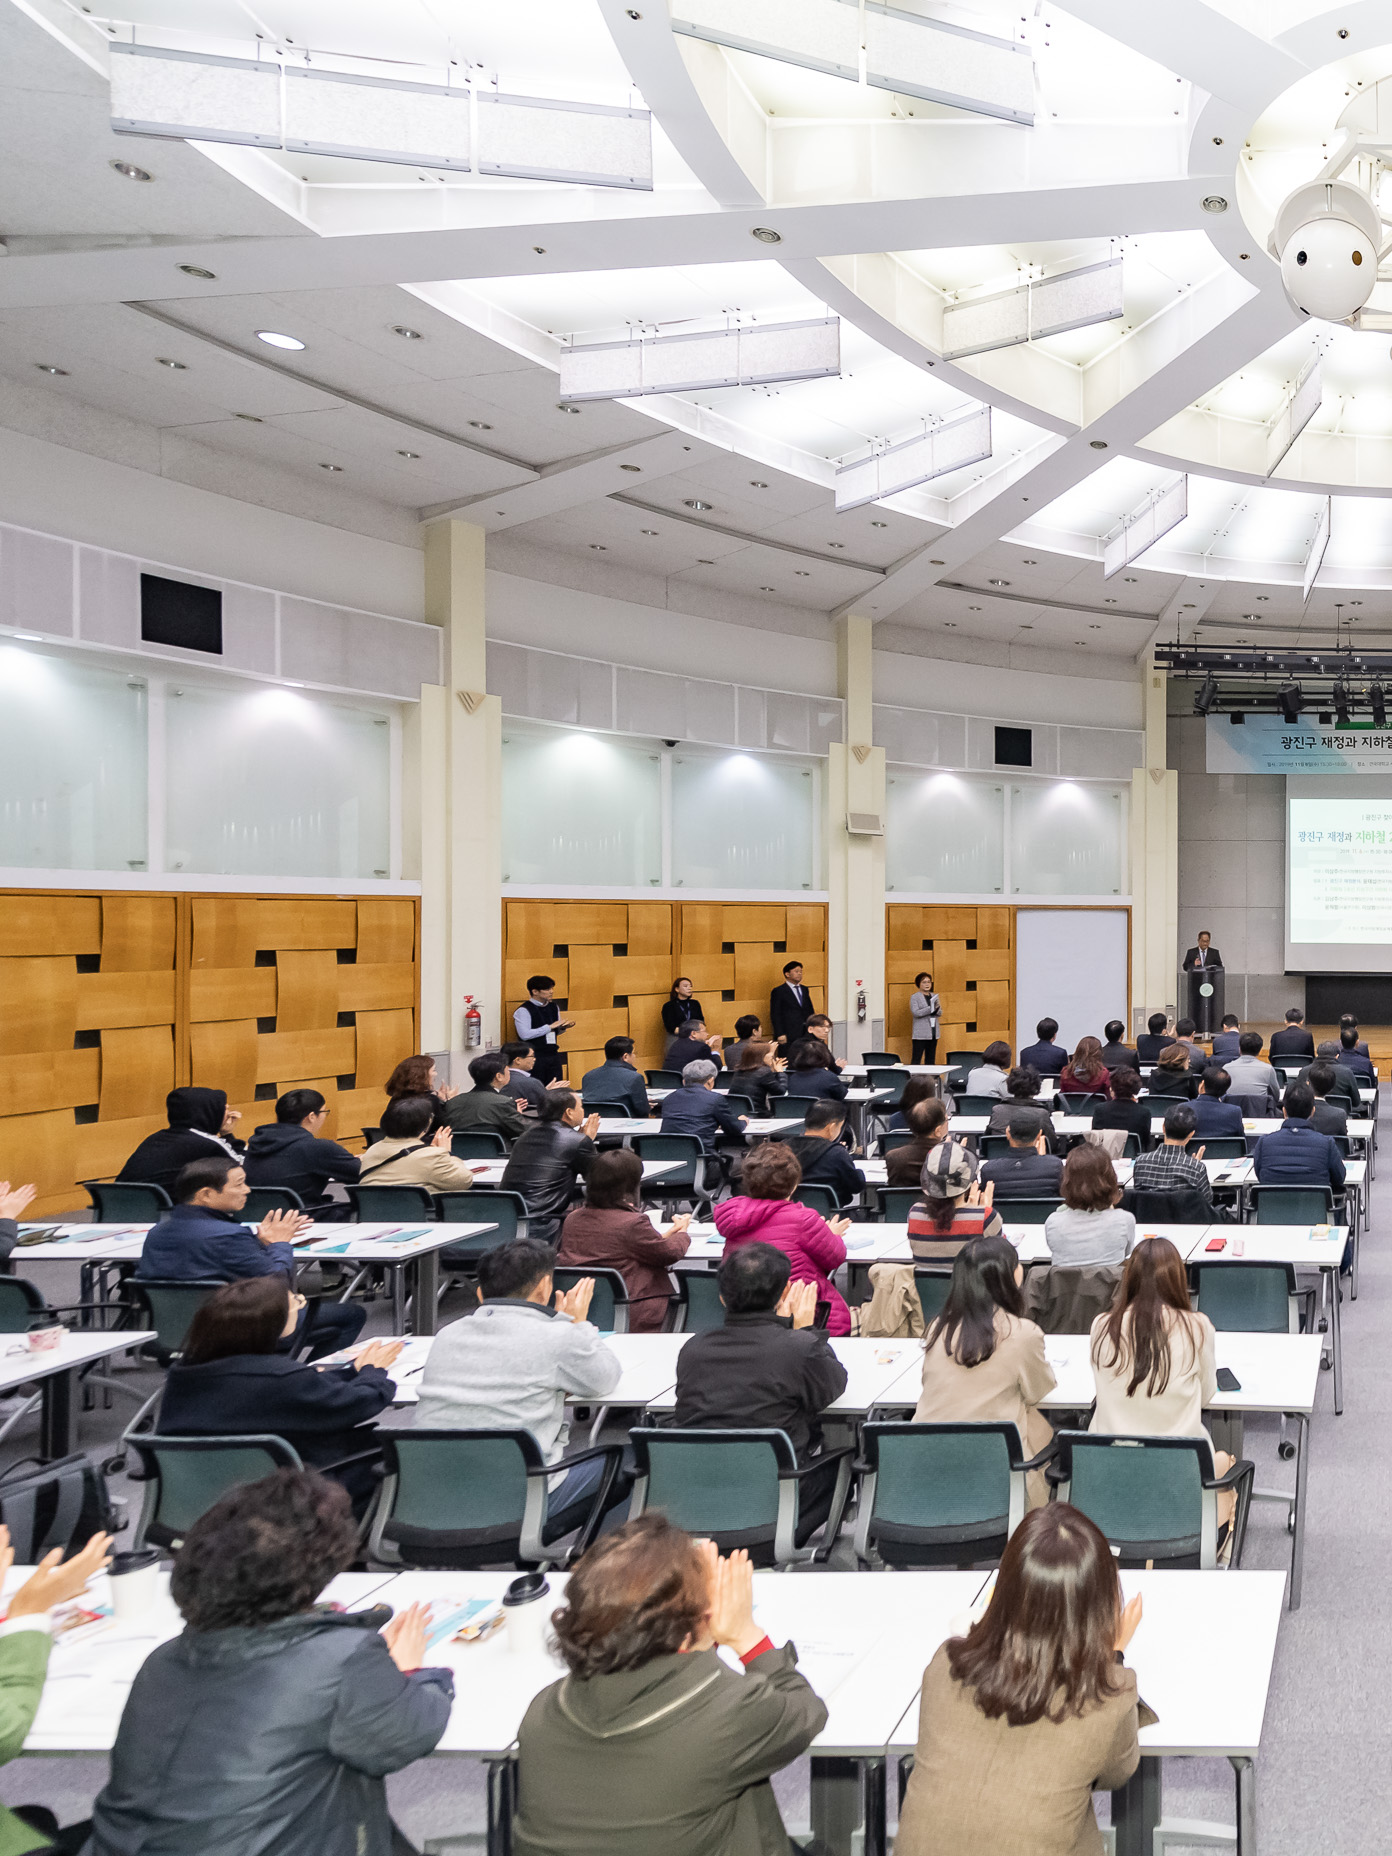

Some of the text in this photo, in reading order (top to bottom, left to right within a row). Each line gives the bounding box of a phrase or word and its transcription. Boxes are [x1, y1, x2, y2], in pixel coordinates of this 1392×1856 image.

[1280, 736, 1317, 750] 광진구
[1321, 736, 1358, 750] 재정과
[1297, 831, 1324, 843] 광진구
[1327, 831, 1353, 843] 재정과
[1355, 830, 1386, 844] 지하철
